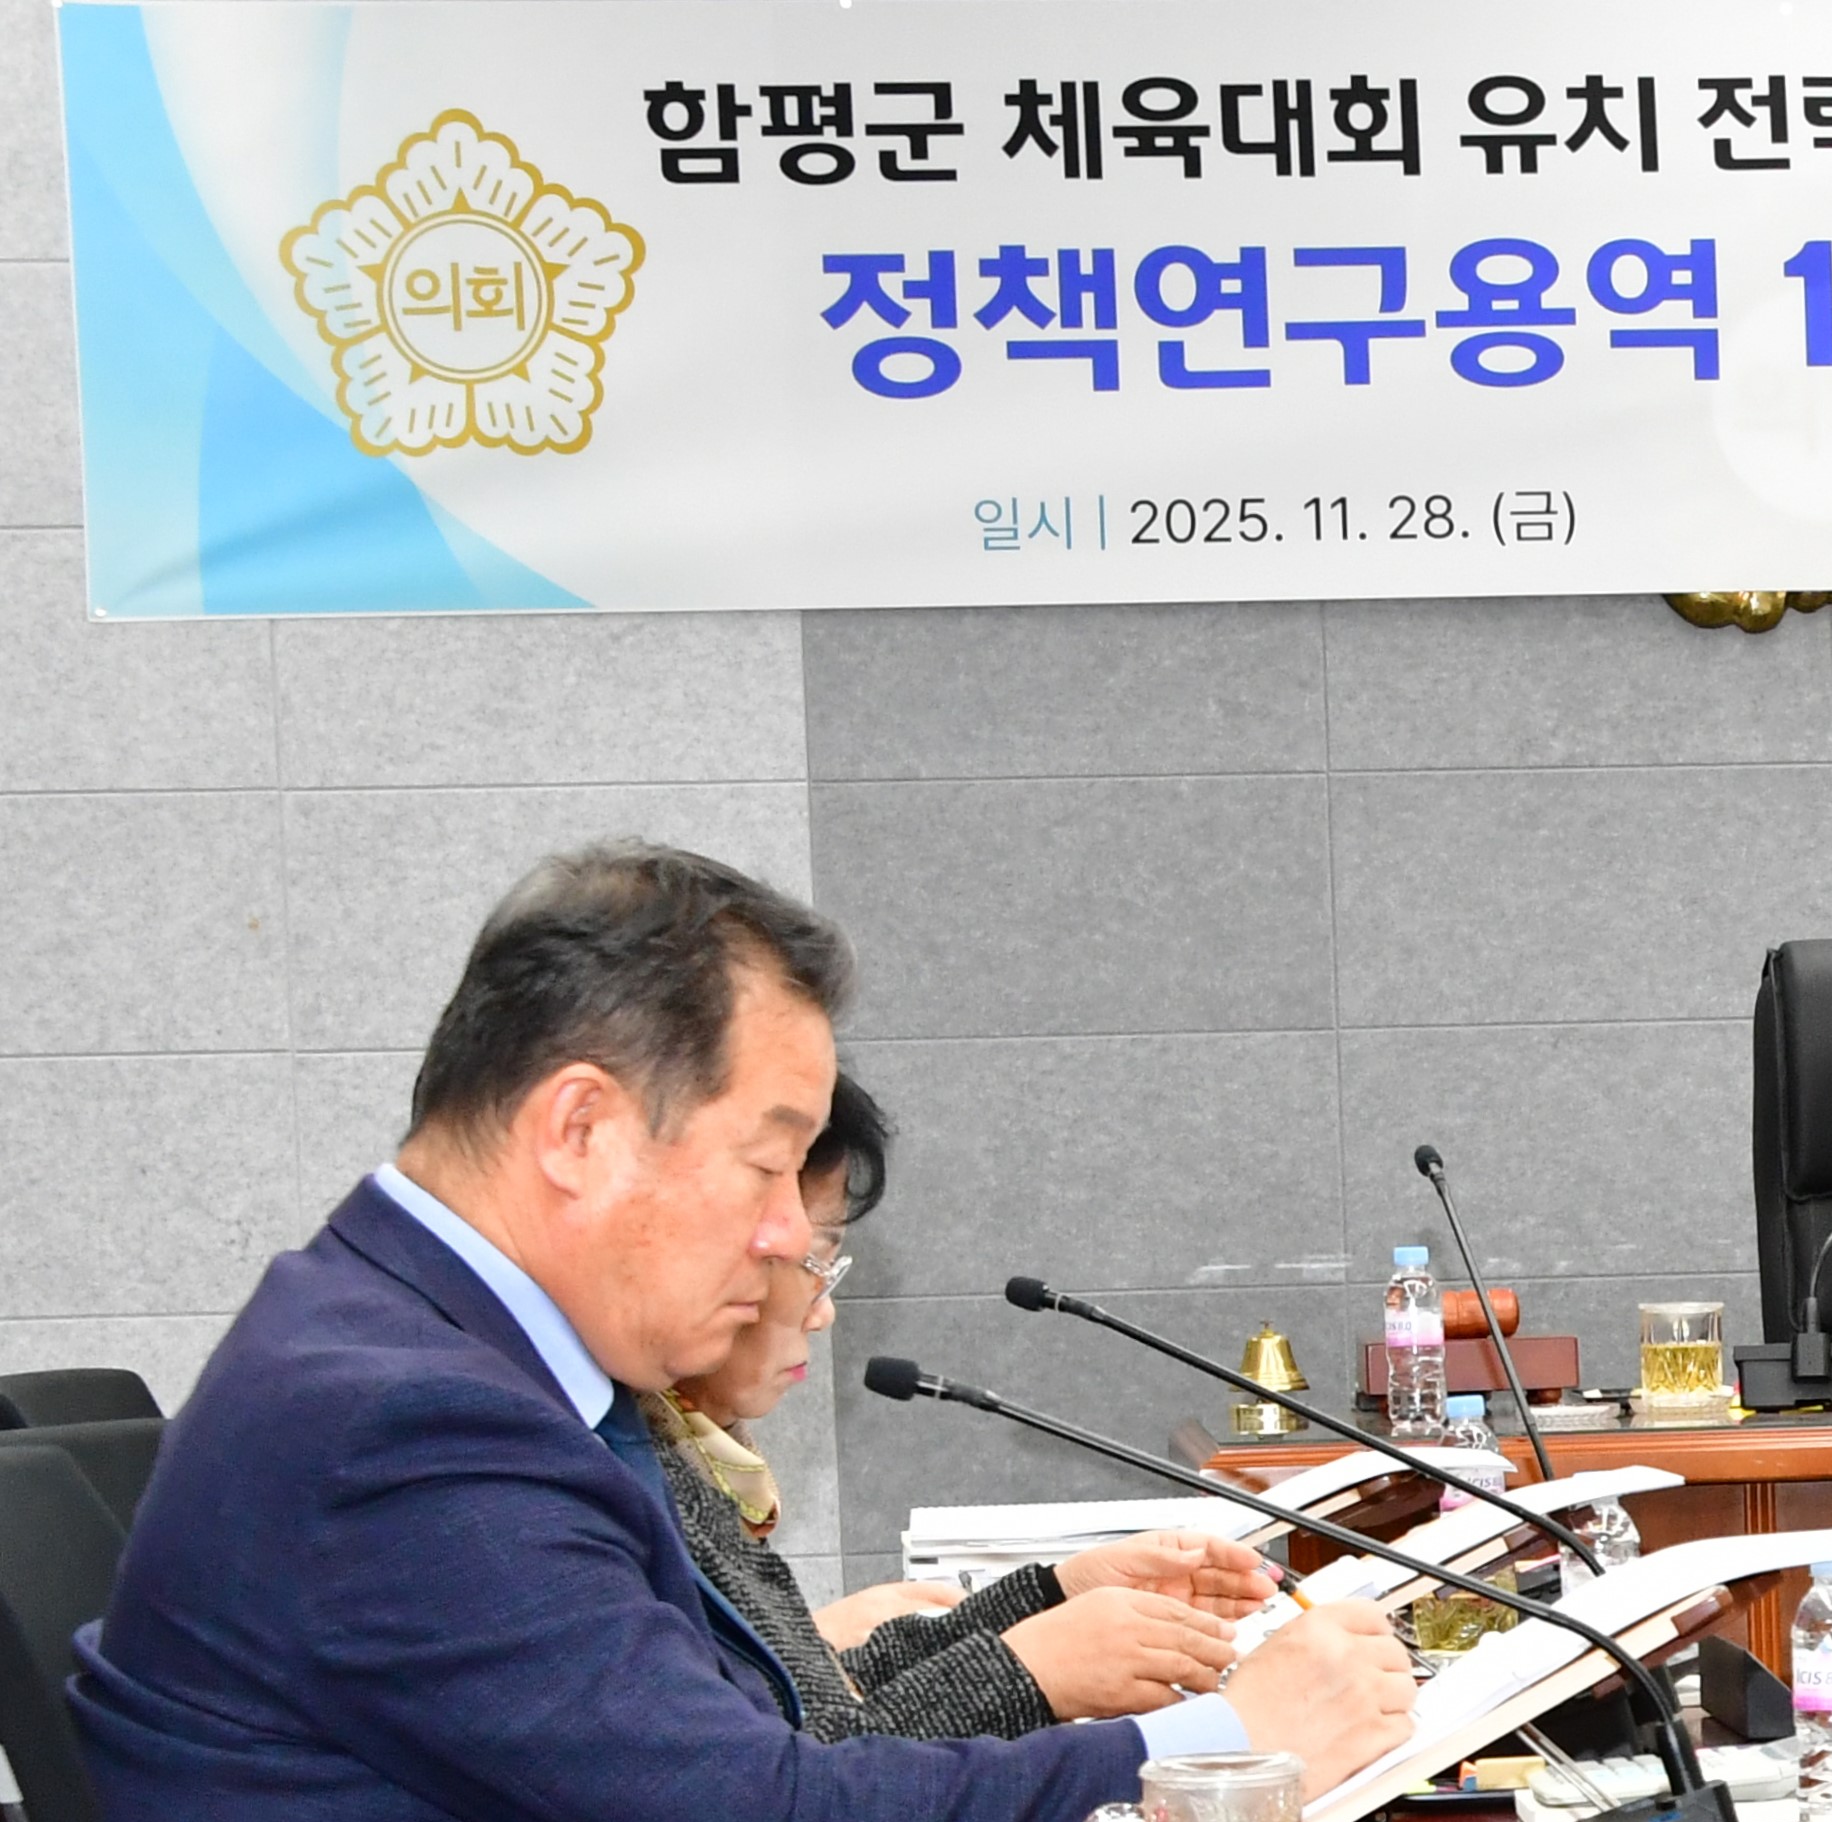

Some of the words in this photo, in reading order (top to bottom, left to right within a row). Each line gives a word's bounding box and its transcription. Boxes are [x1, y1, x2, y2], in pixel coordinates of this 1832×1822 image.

[644, 81, 964, 185] 함평군
[1003, 75, 1420, 179] 체육대회
[1460, 75, 1658, 173] 유치
[402, 261, 525, 331] 의회
[821, 238, 1719, 399] 정책연구용역
[974, 496, 1071, 551] 일시
[1131, 498, 1283, 544] 2025.
[1304, 497, 1367, 541] 11.
[1389, 495, 1470, 540] 28.
[1493, 491, 1576, 546] (금)
